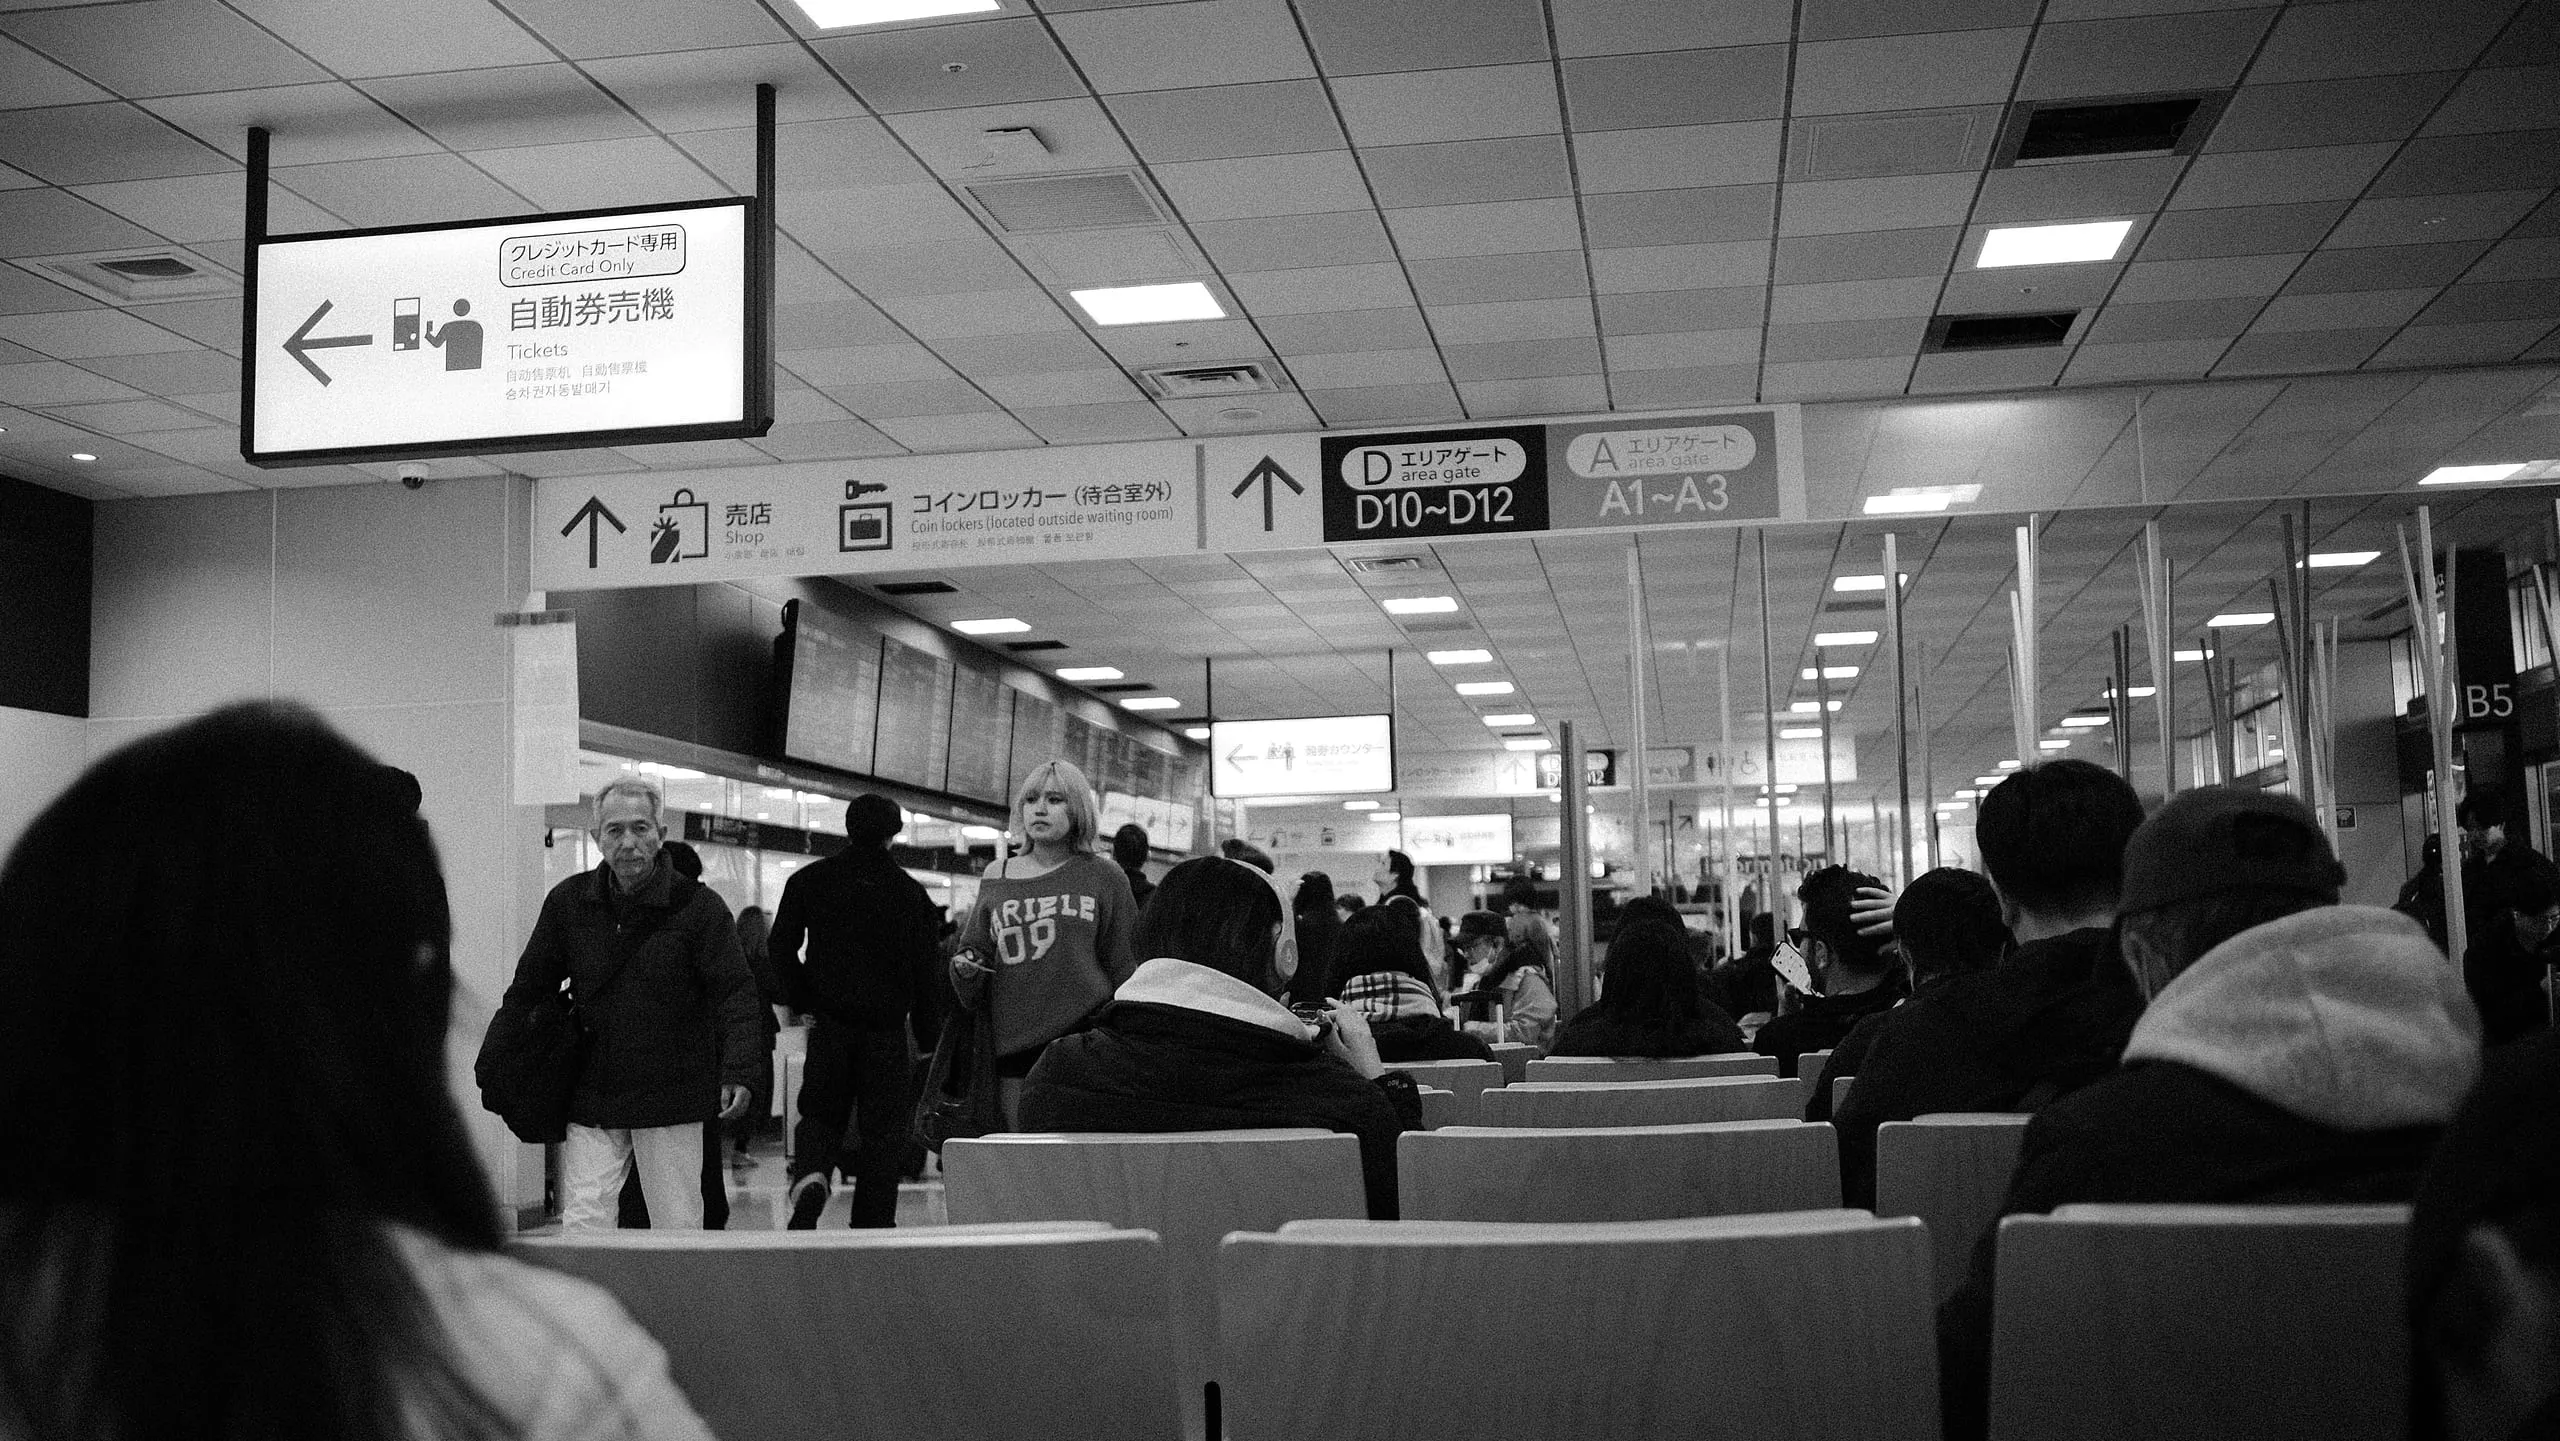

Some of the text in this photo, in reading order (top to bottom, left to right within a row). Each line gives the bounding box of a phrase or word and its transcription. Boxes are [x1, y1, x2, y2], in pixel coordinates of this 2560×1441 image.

[511, 232, 677, 262] クレジットカード専用
[510, 258, 635, 280] Credit Card Only
[511, 286, 675, 331] 自動券売機
[507, 342, 569, 360] Tickets
[1589, 436, 1620, 473] A
[1628, 433, 1737, 454] エリアゲート
[1363, 450, 1393, 486] D
[1401, 446, 1507, 467] エリアゲート
[1628, 454, 1710, 471] area gate
[1401, 466, 1481, 483] area gate
[726, 501, 772, 526] 売店
[911, 506, 1173, 533] Coin lockers (located outside waiting room)
[726, 530, 764, 546] Shop
[2466, 684, 2513, 718] B5
[997, 918, 1056, 965] 09
